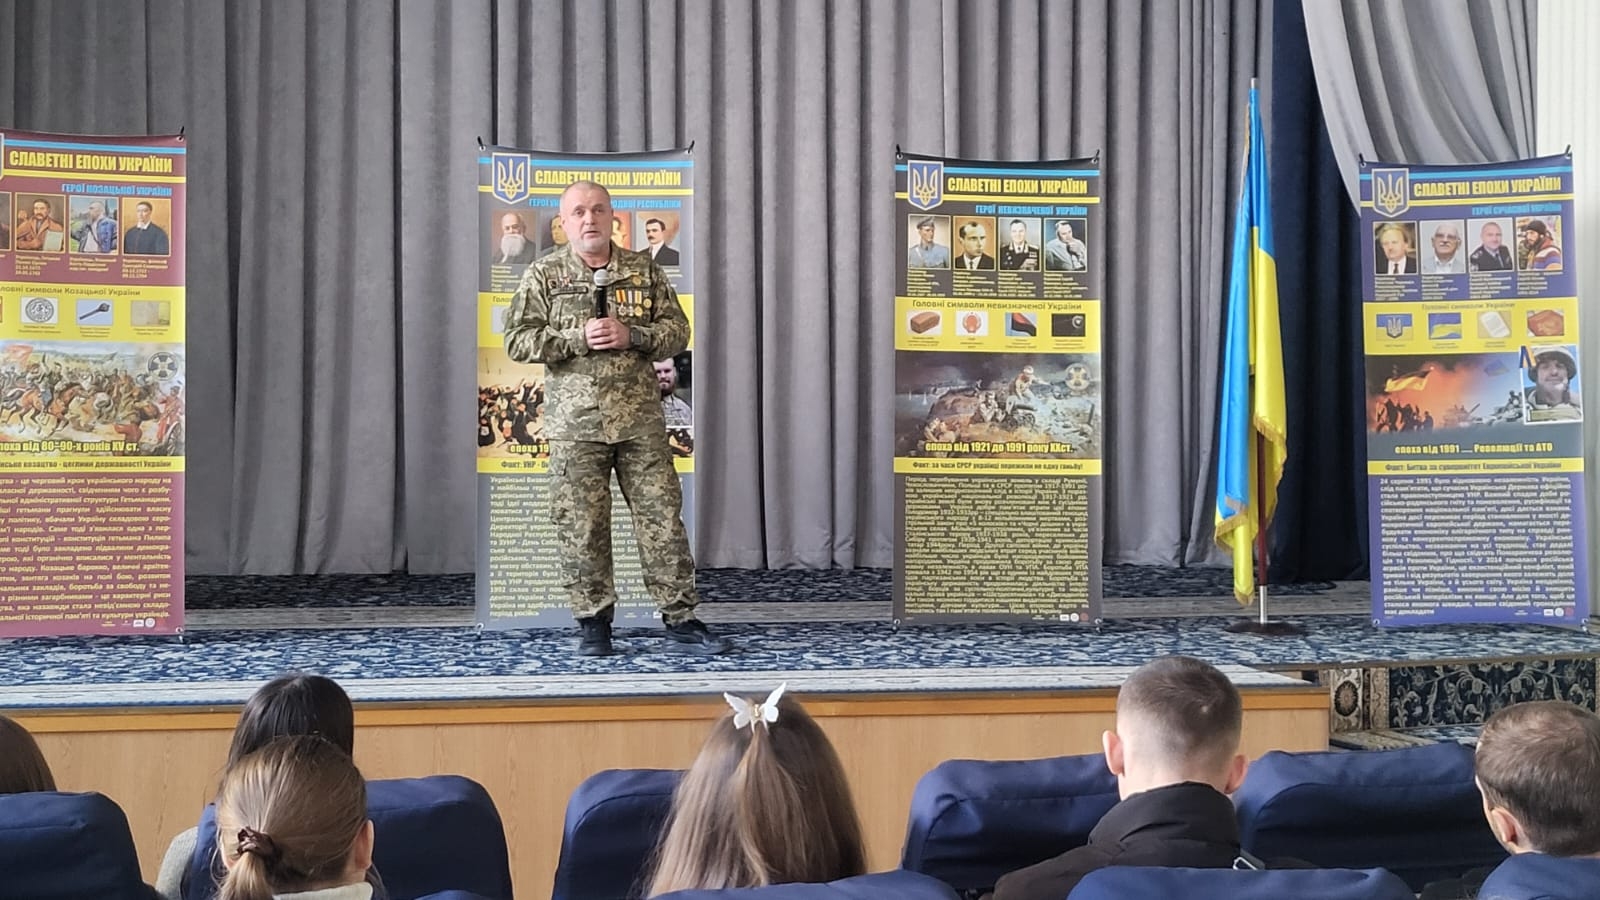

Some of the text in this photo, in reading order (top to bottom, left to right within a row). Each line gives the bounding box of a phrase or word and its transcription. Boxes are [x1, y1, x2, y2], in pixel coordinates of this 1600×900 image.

[9, 150, 172, 173] СЛАВЕТНІ ЕПОХИ УКРАЇНИ
[535, 169, 681, 186] СЛАВЕТНІ ЕПОХИ УКРАЇНИ
[61, 183, 172, 197] ГЕРОЇ КОЗАЦЬКОЇ УКРАЇНИ
[947, 177, 1087, 194] СЛАВЕТНІ ЕПОХИ УКРАЇНИ
[1413, 176, 1561, 197] СЛАВЕТНІ ЕПОХИ УКРАЇНИ
[528, 198, 549, 207] ГЕРОЇ
[637, 200, 681, 209] РЕСПУБЛІКИ
[975, 203, 1087, 215] ГЕРОЇ НЕВИЗНАЧЕНОЇ УКРАЇНИ
[1472, 203, 1561, 215] ГЕРОЇ СУЧАСНОЇ УКРАЇНИ
[65, 287, 106, 296] Козацької
[109, 289, 141, 297] України
[912, 300, 944, 308] Головні
[987, 302, 1045, 310] невизначеної
[22, 441, 40, 452] від
[83, 441, 110, 452] років
[125, 442, 140, 451] ст.
[511, 444, 549, 453] епоха 19
[925, 443, 952, 451] епоха
[953, 442, 970, 452] від
[971, 442, 990, 452] 1921
[991, 443, 1004, 453] до
[1005, 442, 1026, 452] 1991
[1027, 443, 1049, 453] року
[1395, 443, 1552, 454] епоха від 1991 Революції та АТО
[95, 460, 142, 469] державності
[143, 460, 171, 468] України
